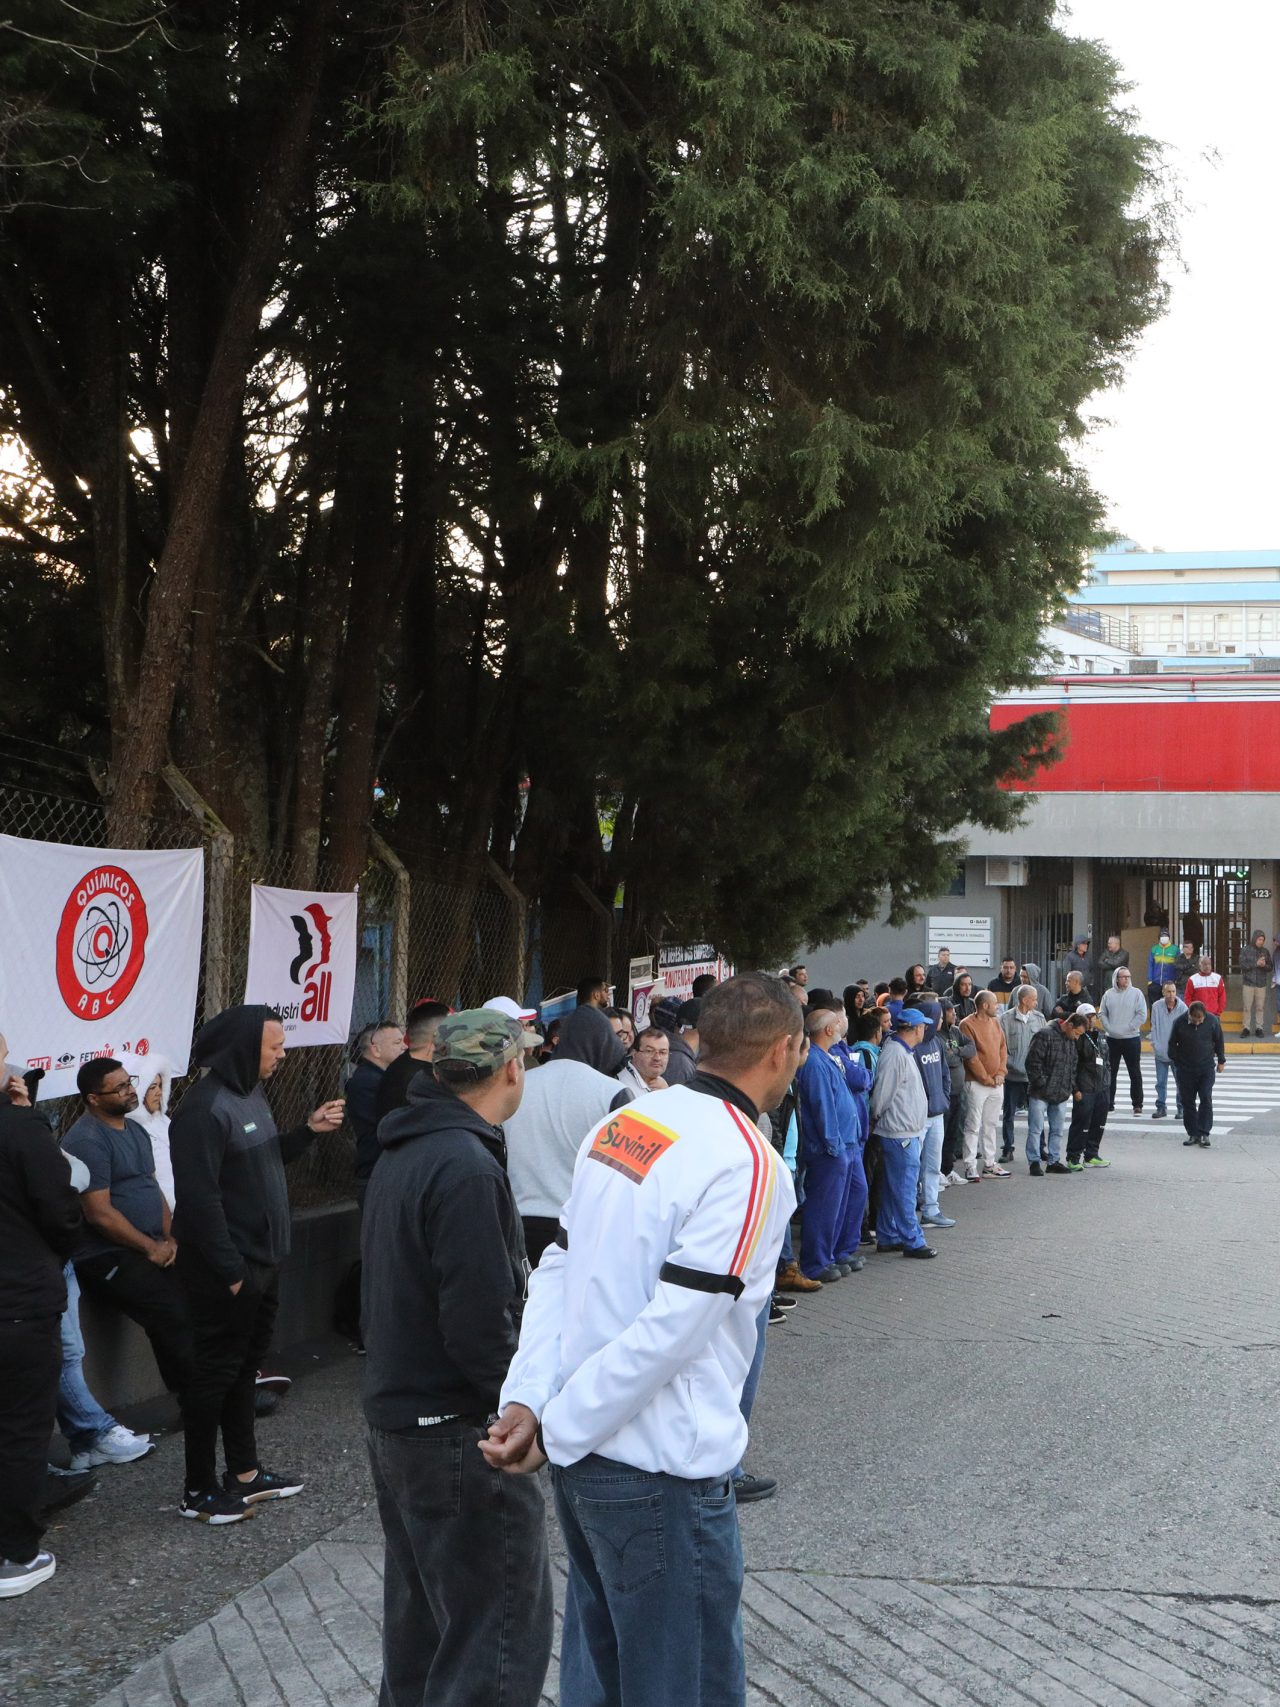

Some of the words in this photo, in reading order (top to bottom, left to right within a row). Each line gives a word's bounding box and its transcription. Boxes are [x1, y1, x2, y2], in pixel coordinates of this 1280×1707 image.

[77, 870, 135, 908] QUÍMICOS
[301, 971, 332, 1022] all
[600, 1121, 663, 1166] Suvinil
